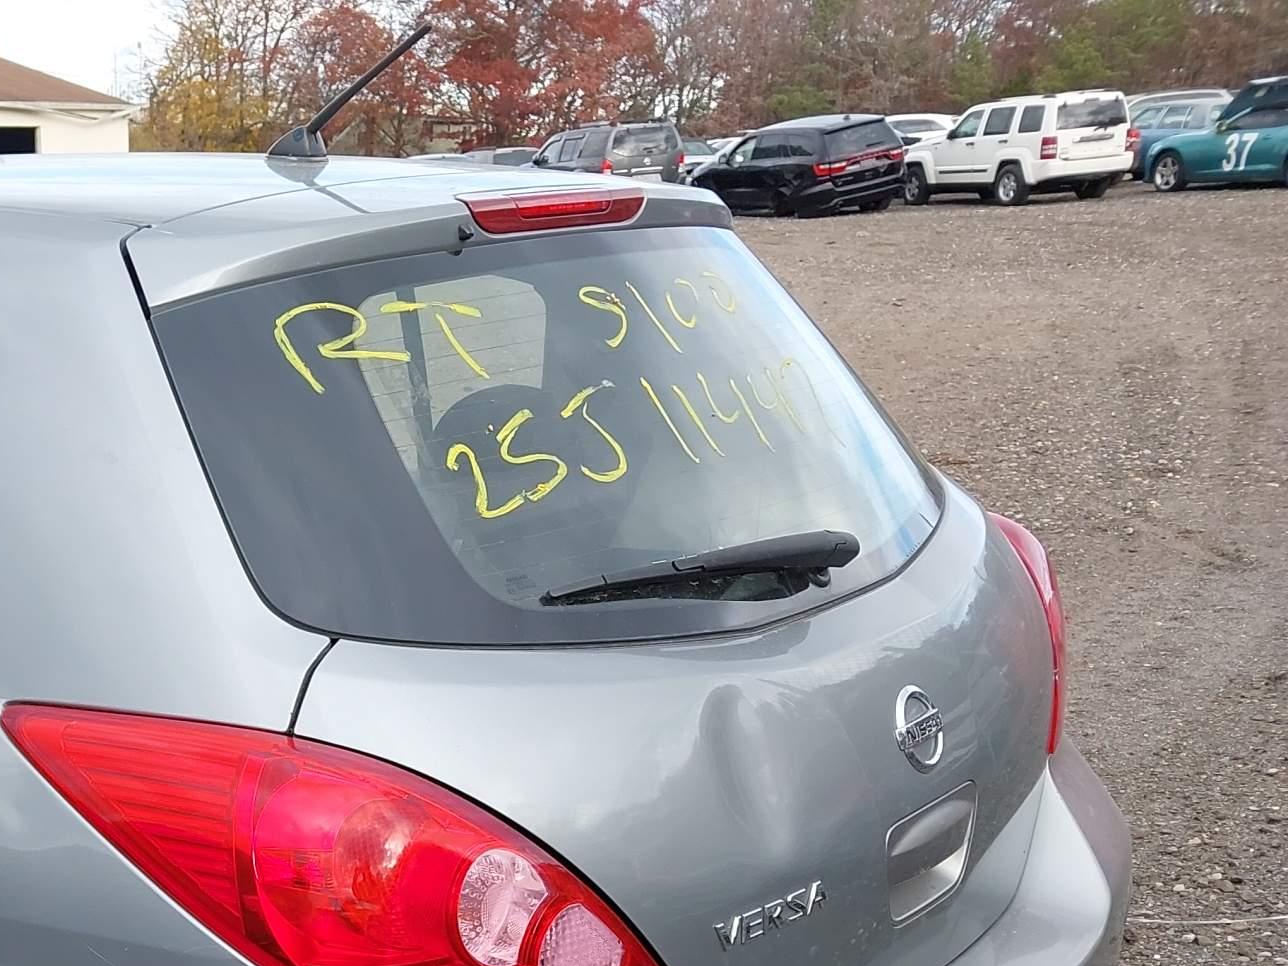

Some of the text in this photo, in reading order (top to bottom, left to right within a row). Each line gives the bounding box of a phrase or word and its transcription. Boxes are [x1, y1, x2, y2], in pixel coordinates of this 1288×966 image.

[1222, 132, 1260, 172] 37
[274, 301, 491, 394] RT
[712, 880, 826, 952] VERSA
